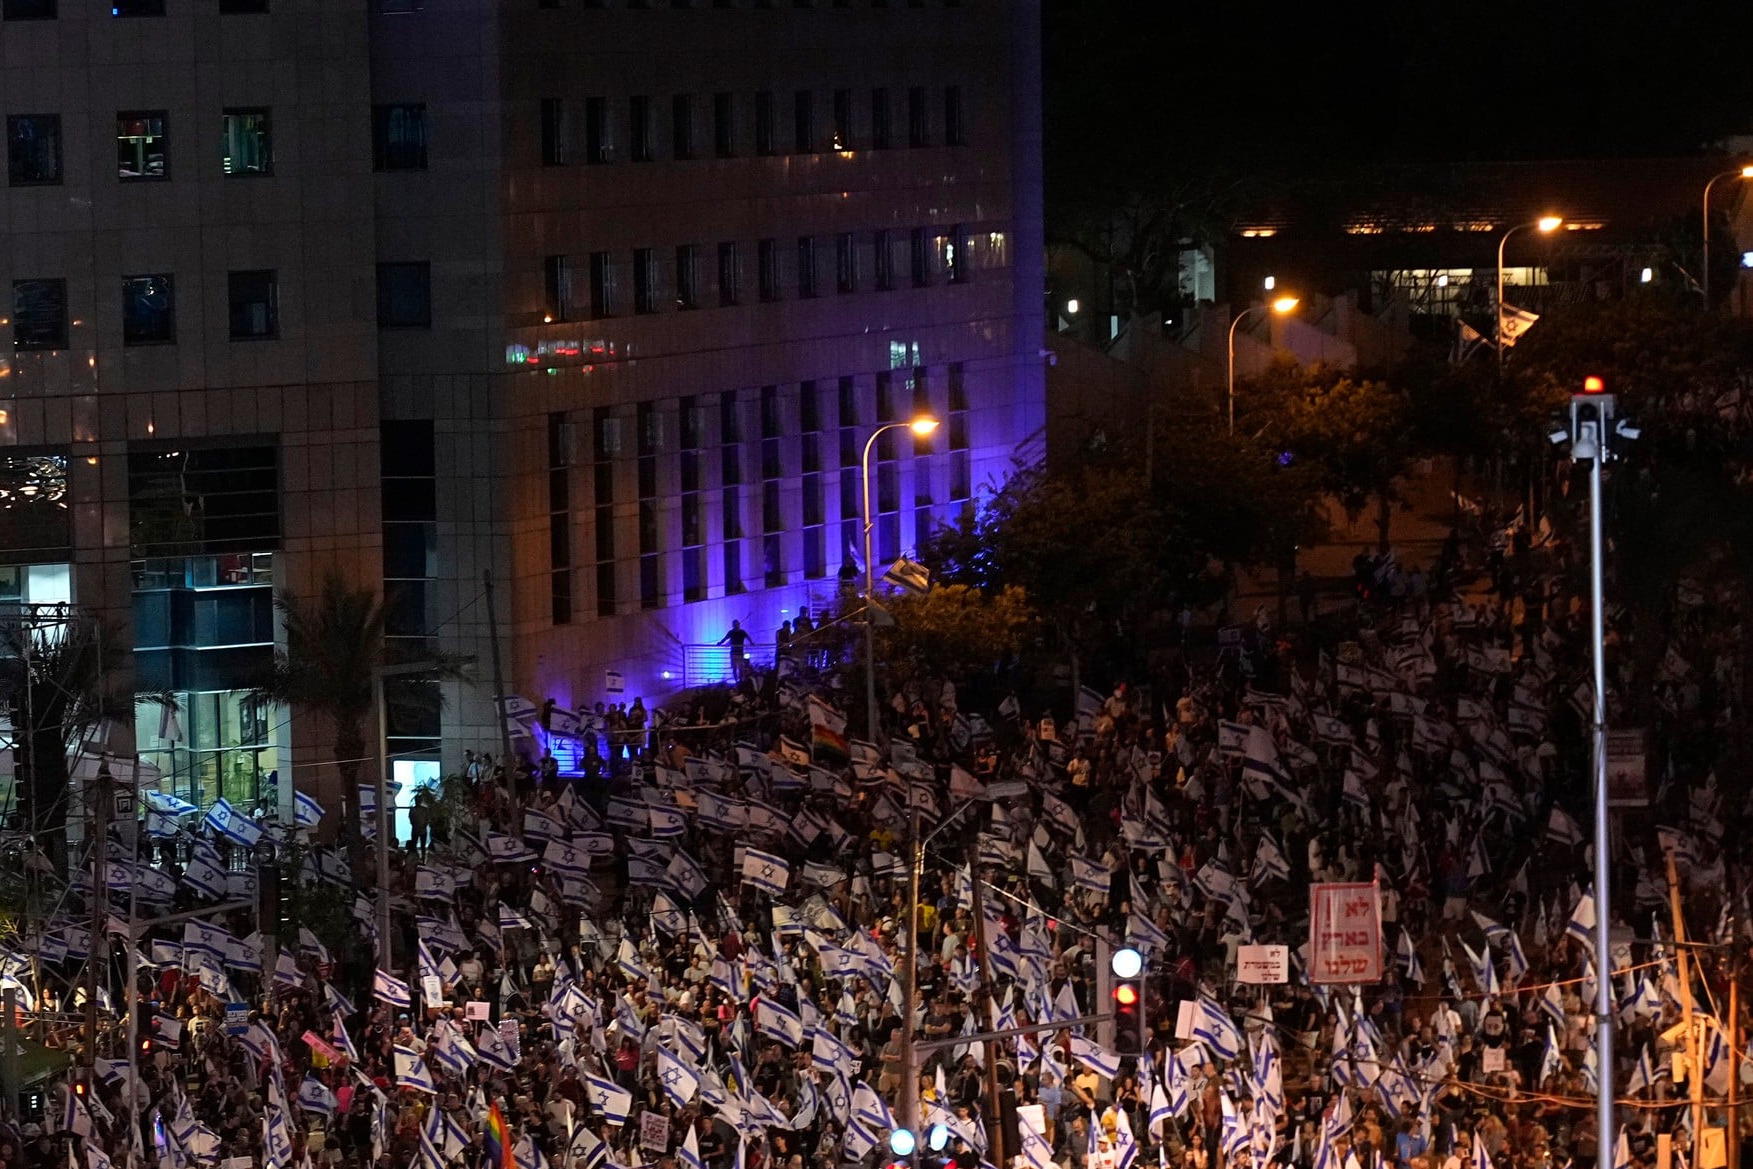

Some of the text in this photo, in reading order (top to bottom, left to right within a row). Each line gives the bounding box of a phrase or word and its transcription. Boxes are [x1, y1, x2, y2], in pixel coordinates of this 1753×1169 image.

[1345, 897, 1370, 918] לא
[1321, 930, 1370, 950] בארץ
[1324, 955, 1369, 976] שלנו
